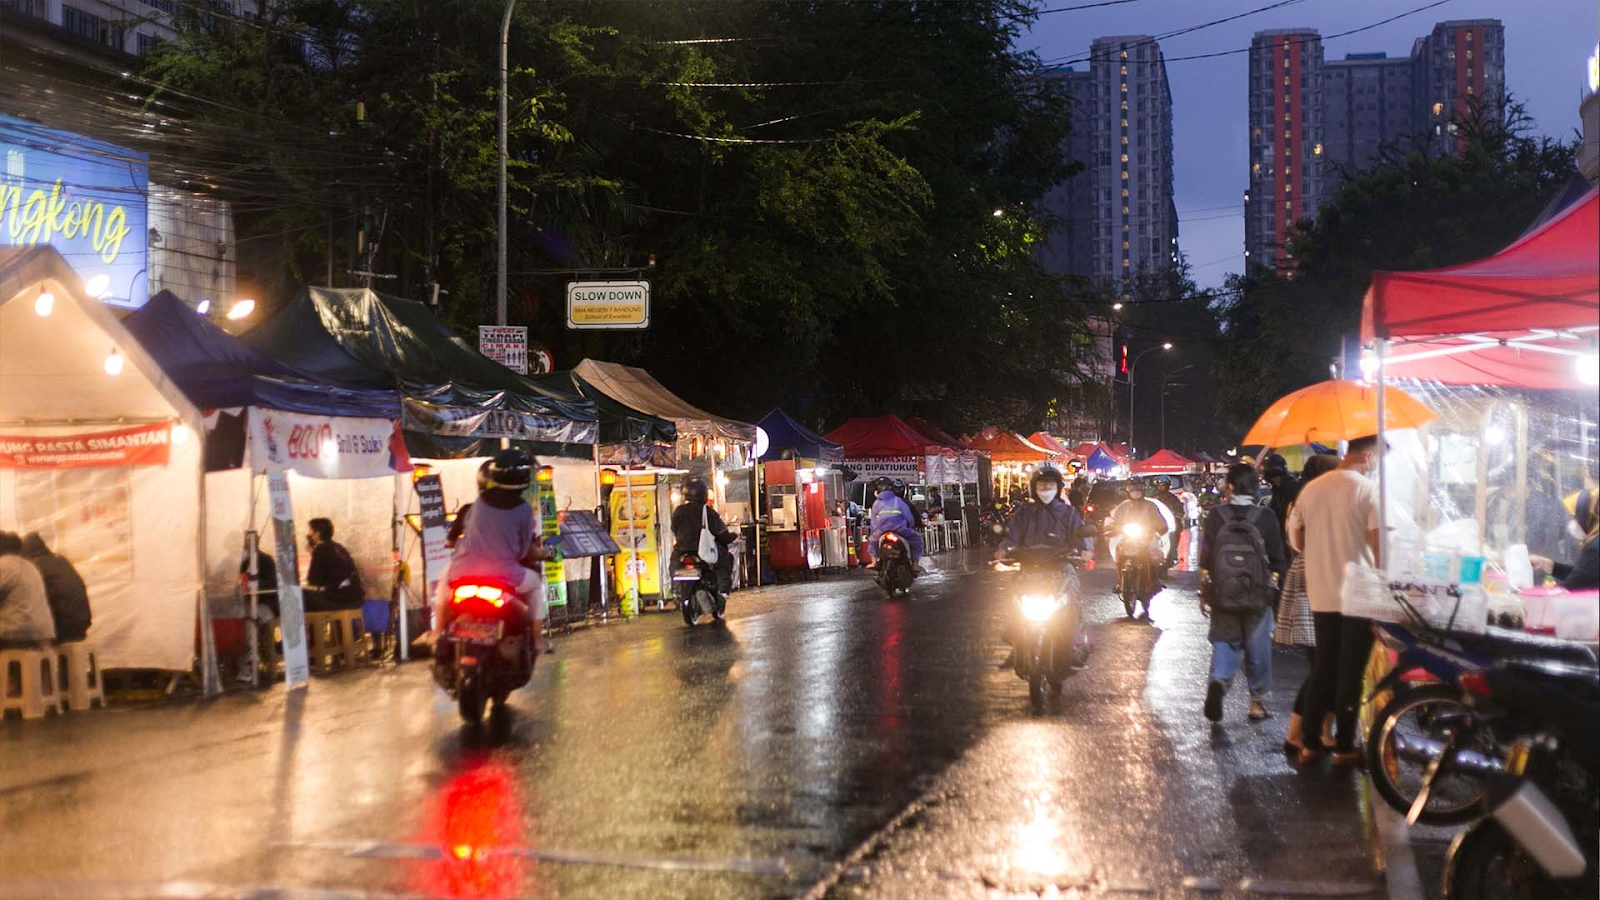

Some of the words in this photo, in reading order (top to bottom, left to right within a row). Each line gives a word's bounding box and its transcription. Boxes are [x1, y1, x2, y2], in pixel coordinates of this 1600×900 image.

[574, 292, 606, 301] SLOW
[609, 291, 642, 300] DOWN
[35, 441, 86, 453] PASTA
[87, 429, 168, 451] SIMANTAN
[865, 463, 918, 472] DIPATIUKUR
